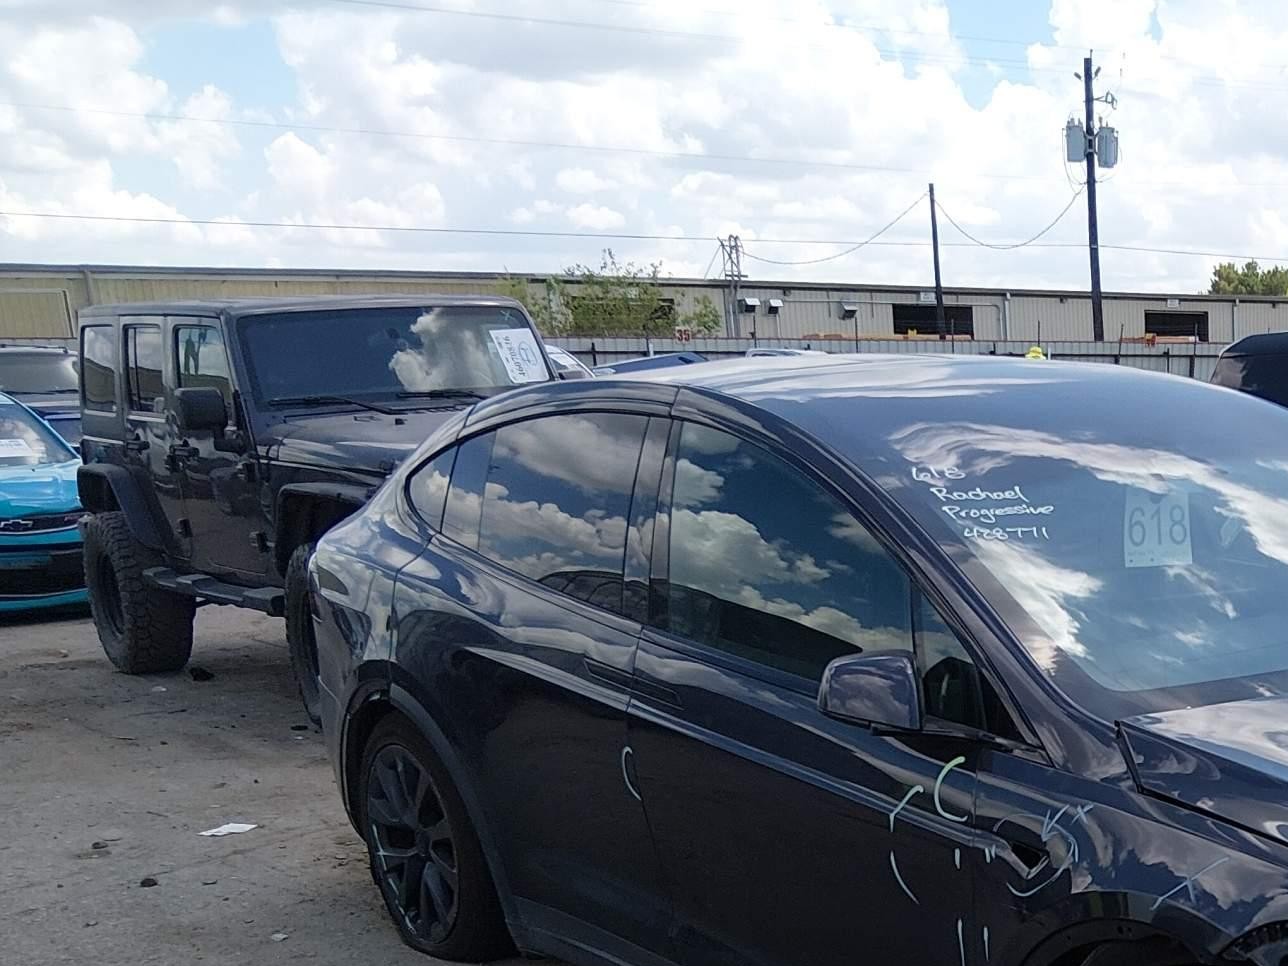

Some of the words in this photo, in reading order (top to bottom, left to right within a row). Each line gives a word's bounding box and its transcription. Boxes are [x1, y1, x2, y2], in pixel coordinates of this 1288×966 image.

[676, 329, 690, 342] 35
[911, 466, 967, 480] 618
[929, 486, 1030, 503] Rachael
[941, 505, 1055, 524] Progressive
[1128, 504, 1187, 547] 618
